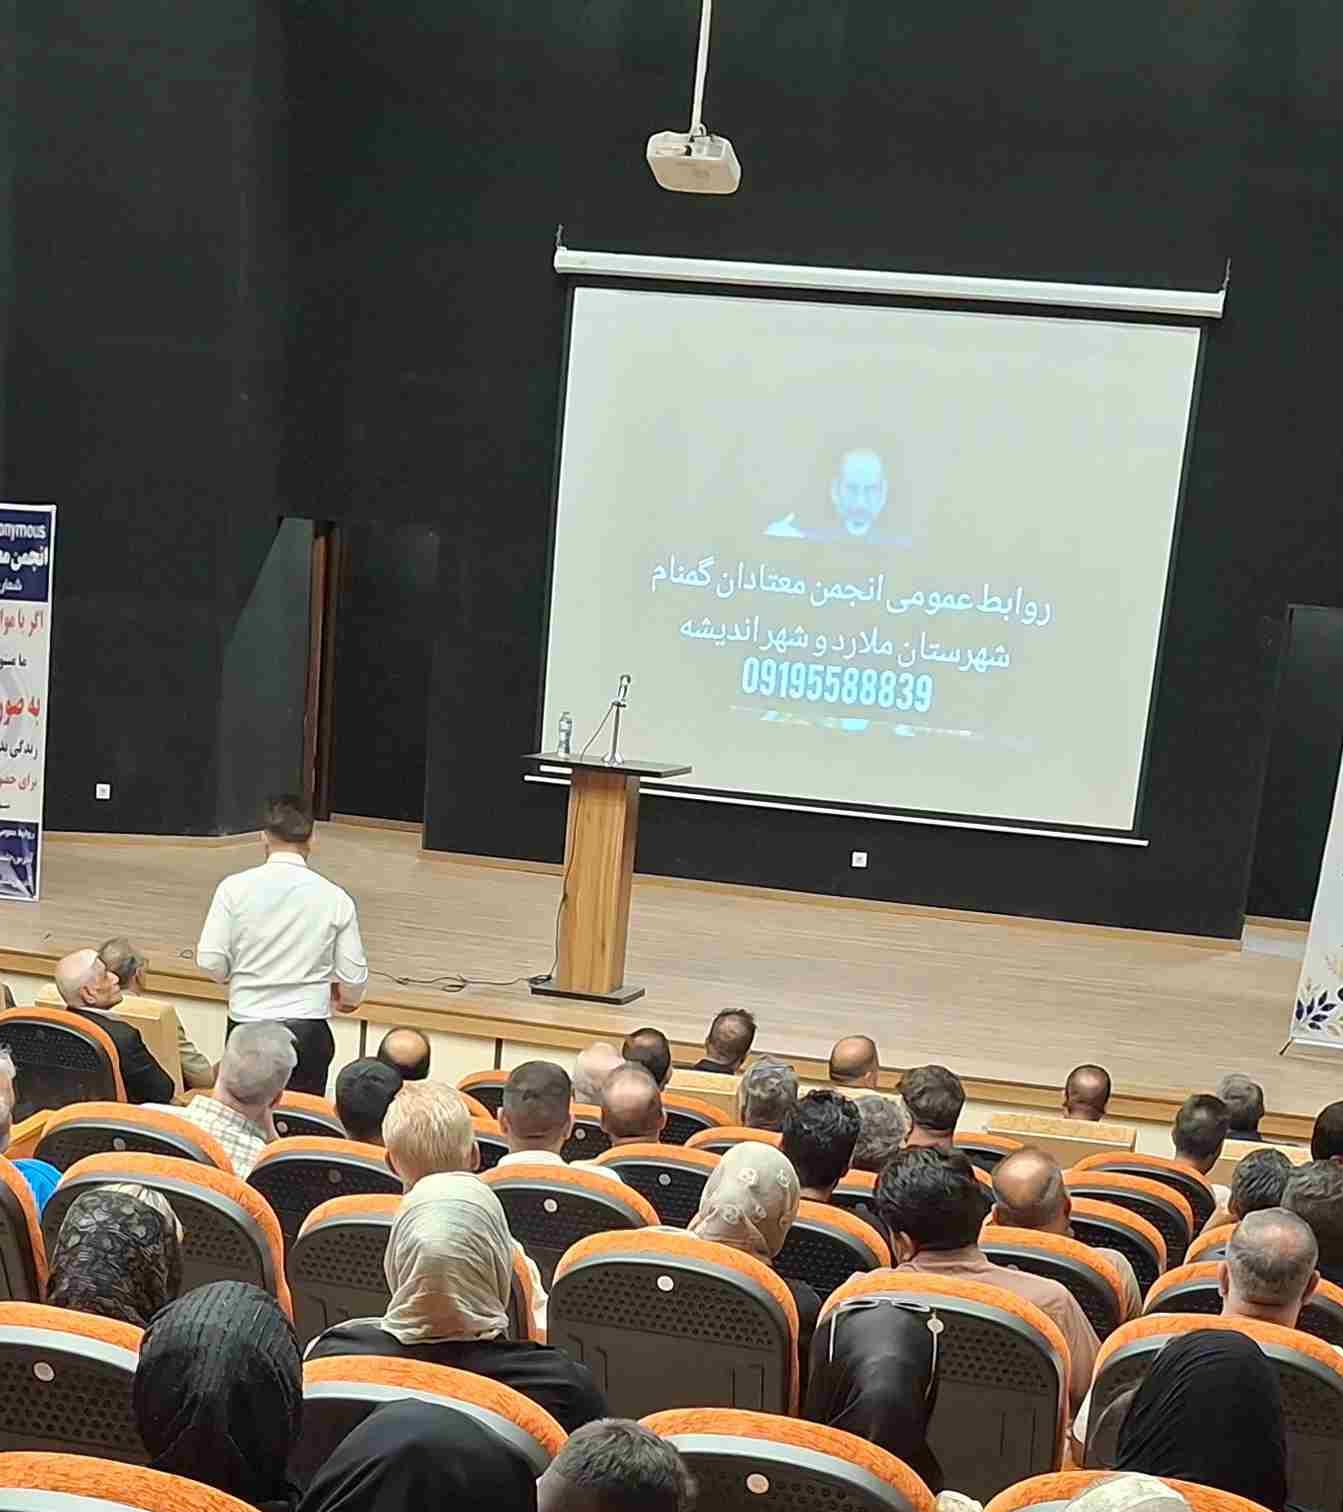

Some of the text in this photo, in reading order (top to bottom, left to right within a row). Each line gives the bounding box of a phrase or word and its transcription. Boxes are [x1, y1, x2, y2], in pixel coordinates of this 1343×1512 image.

[10, 546, 49, 572] انجمن
[652, 553, 1051, 627] روابط عمومی انجمن معتادان گمنام
[28, 608, 44, 637] اگر
[679, 614, 1011, 673] شهرستان ملارد و شهر اندیشه
[742, 655, 934, 713] 09195588839
